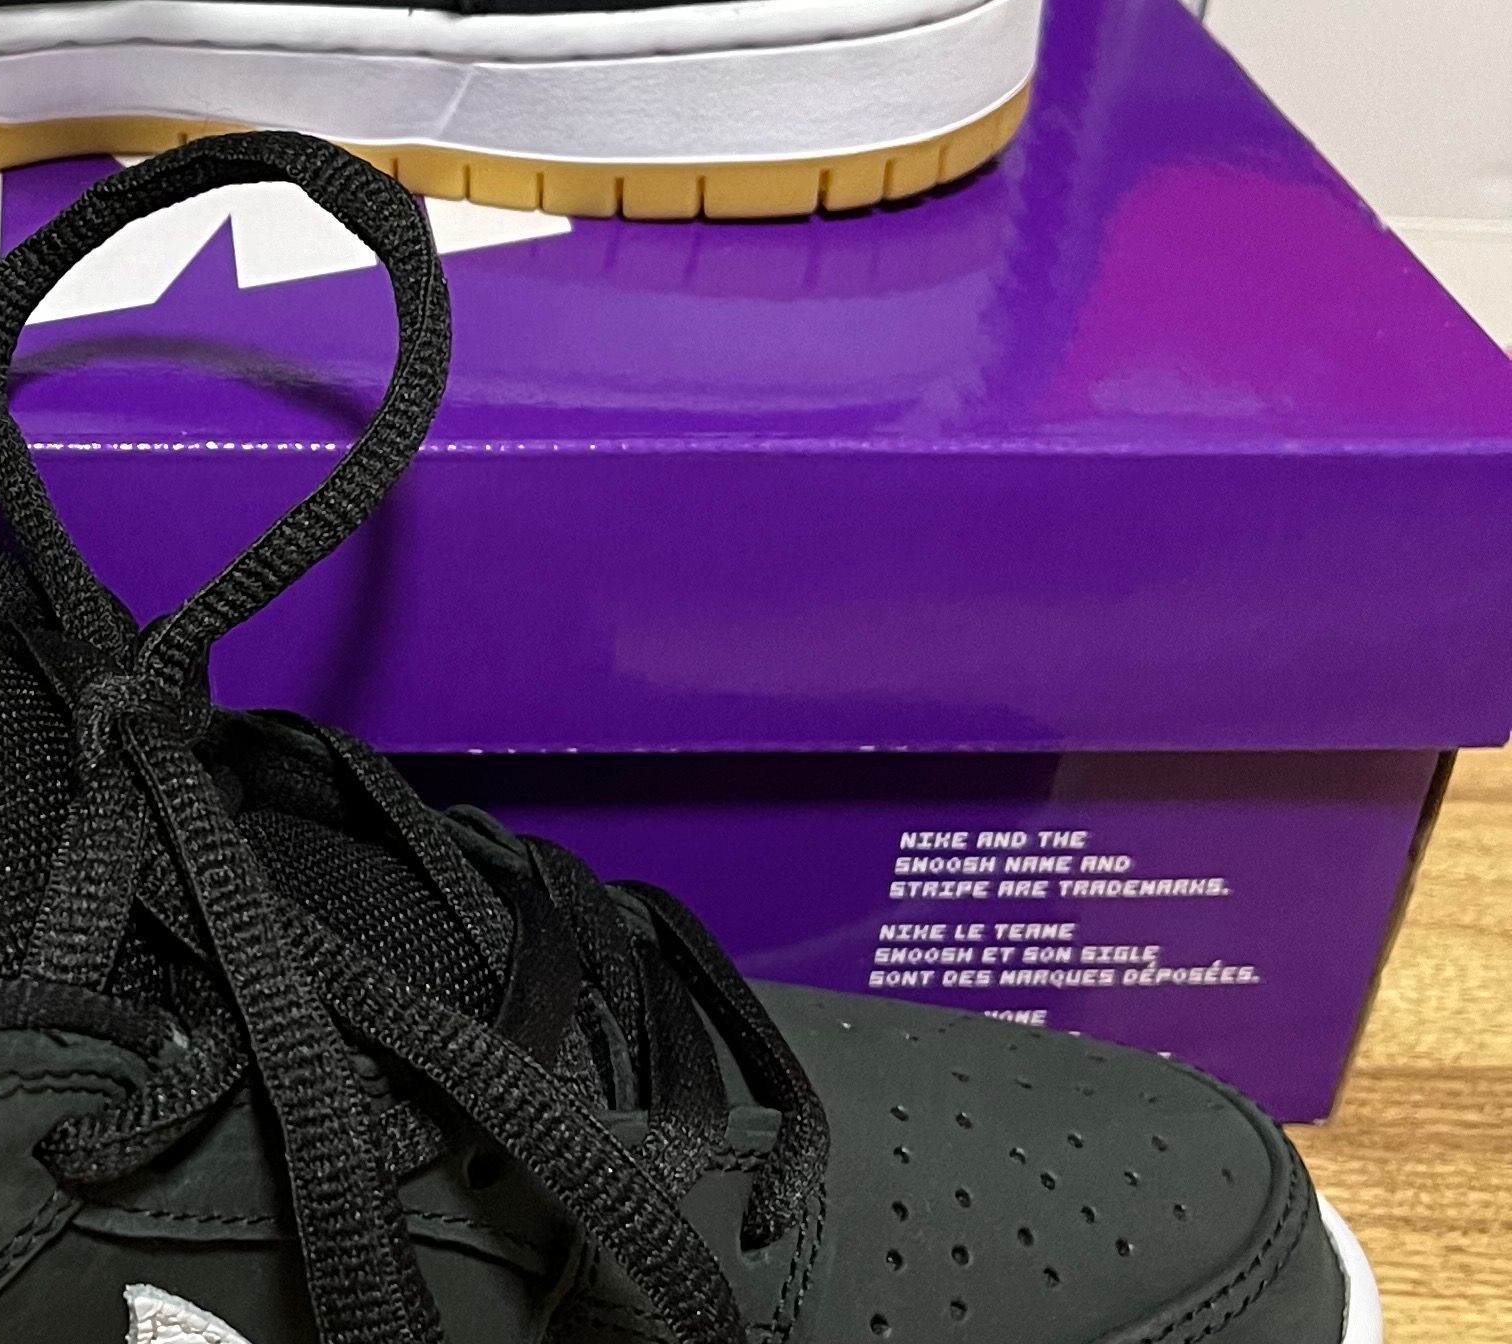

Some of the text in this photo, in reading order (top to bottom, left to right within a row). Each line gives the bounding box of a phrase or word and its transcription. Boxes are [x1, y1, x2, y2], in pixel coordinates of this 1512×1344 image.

[900, 831, 1087, 849] NIKE AND THE
[895, 856, 1132, 874] SWOOSH NAME AND
[889, 878, 1230, 898] STRIPE ARE TRADEMARKS.
[879, 923, 1075, 941] NIKE LE TERME
[874, 945, 1160, 964] SWOOSH ET SON SIGLE
[868, 971, 934, 988] SONT
[942, 970, 990, 987] DES
[999, 969, 1114, 988] MARQUES
